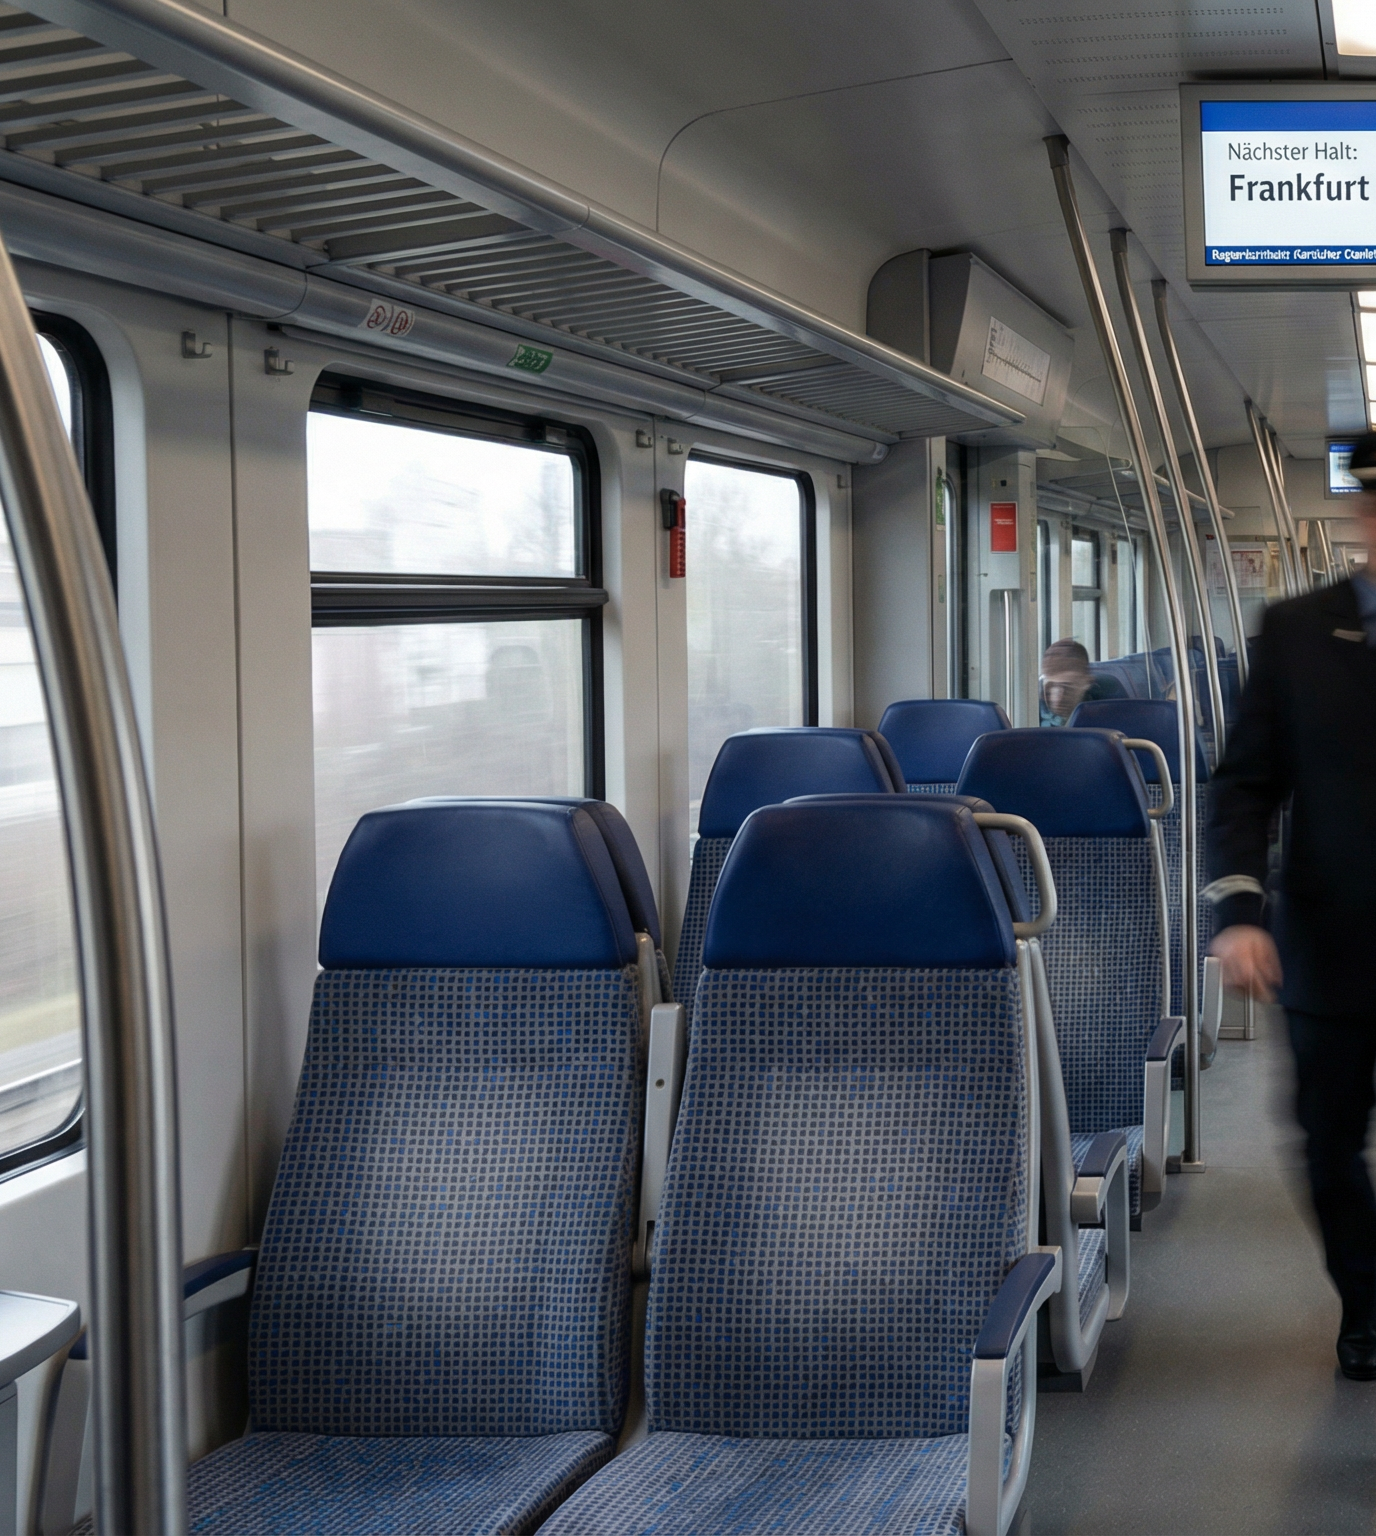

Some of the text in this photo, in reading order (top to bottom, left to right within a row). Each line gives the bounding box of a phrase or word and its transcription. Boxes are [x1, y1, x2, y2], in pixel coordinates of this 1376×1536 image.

[1228, 141, 1358, 160] Nächster Halt:
[1229, 172, 1370, 201] Frankfurt
